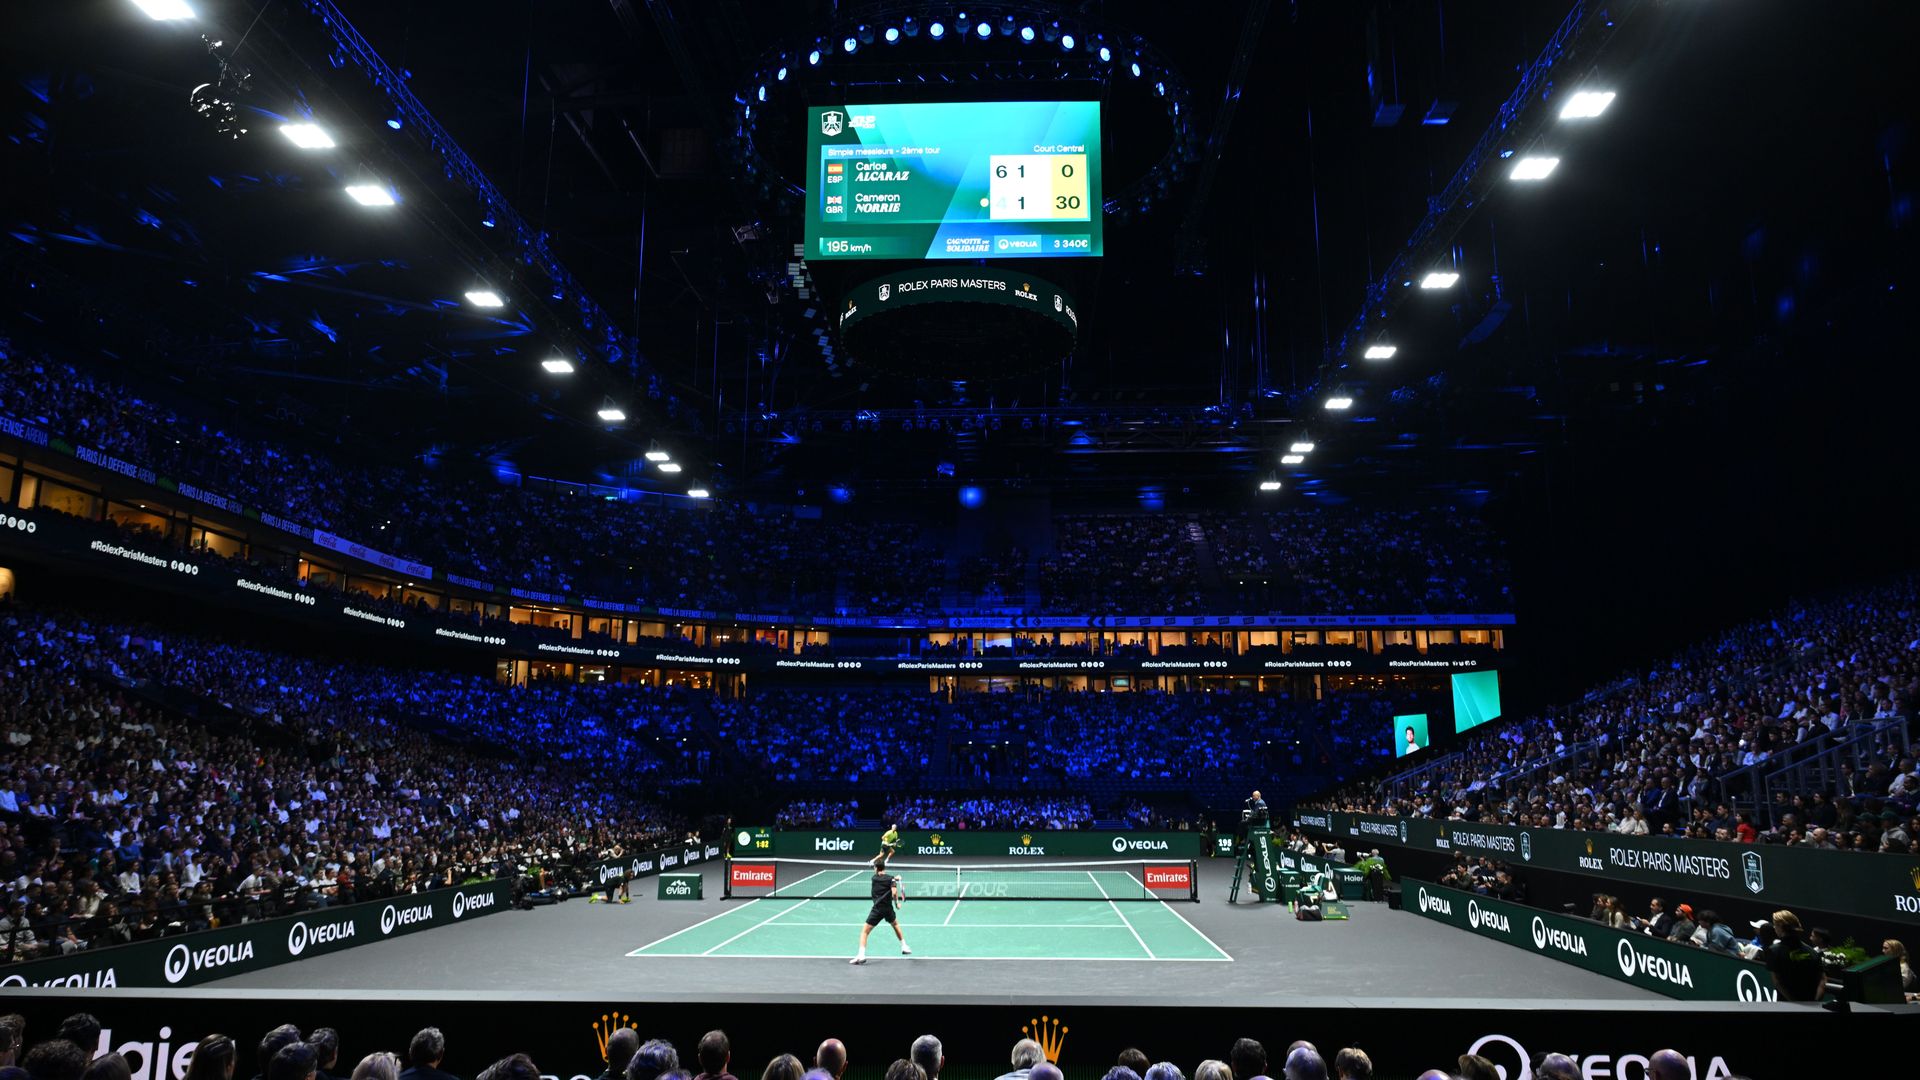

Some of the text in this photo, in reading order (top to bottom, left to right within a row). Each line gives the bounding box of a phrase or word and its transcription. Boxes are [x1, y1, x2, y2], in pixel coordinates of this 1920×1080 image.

[925, 146, 940, 154] tour
[855, 162, 887, 171] Carlos
[996, 164, 1074, 178] 6 1 0
[855, 171, 910, 181] ALCARAZ
[855, 193, 901, 202] Cameron
[1018, 196, 1025, 209] 1
[1056, 195, 1081, 209] 30
[855, 203, 901, 213] NORRIE
[826, 241, 872, 253] 195 km/h
[946, 245, 990, 253] SOLIDAIRE
[1010, 240, 1038, 248] VEOLIA
[1054, 240, 1088, 248] 3 340€
[898, 279, 1006, 293] ROLEX PARIS MASTERS
[1015, 289, 1038, 301] ROLEX
[76, 444, 99, 466] PARIS
[98, 452, 107, 468] LA
[107, 456, 138, 478] DEFENSE
[91, 540, 167, 568] #RolexParisMasters
[237, 579, 292, 600] #RolexParisMasters
[344, 607, 385, 624] #RolexParisMasters
[435, 628, 482, 642] #RolexParisMasters
[538, 643, 594, 655] #RolexParisMasters
[656, 654, 714, 664] #RolexParisMasters
[776, 660, 835, 669] #RolexParisMasters
[1361, 821, 1398, 837] ROLEX PARIS MASTERS
[815, 837, 854, 851] Haier
[1127, 840, 1168, 851] VEOLIA
[1218, 838, 1232, 847] 195
[1436, 838, 1450, 849] ROLEX
[1452, 831, 1515, 852] ROLEX PARIS MASTERS
[687, 850, 700, 861] VEOLIA
[918, 846, 953, 855] ROLEX
[1009, 846, 1045, 855] ROLEX
[1260, 836, 1272, 877] LEXUS
[638, 861, 653, 872] VEOLIA
[665, 855, 678, 866] VEOLIA
[1579, 856, 1603, 870] ROLEX
[1610, 847, 1641, 868] ROLEX
[1643, 850, 1672, 872] PARIS
[1673, 854, 1730, 879] MASTERS
[733, 871, 773, 881] Emirates
[1147, 872, 1188, 883] Emirates
[666, 885, 691, 895] evian
[917, 883, 957, 897] ATP
[466, 892, 494, 911] VEOLIA
[1427, 895, 1451, 916] VEOLIA
[397, 903, 433, 924] VEOLIA
[1479, 909, 1511, 934] VEOLIA
[308, 920, 355, 946] VEOLIA
[1546, 927, 1588, 957] VEOLIA
[192, 939, 254, 971] VEOLIA
[1636, 951, 1693, 989] VEOLIA
